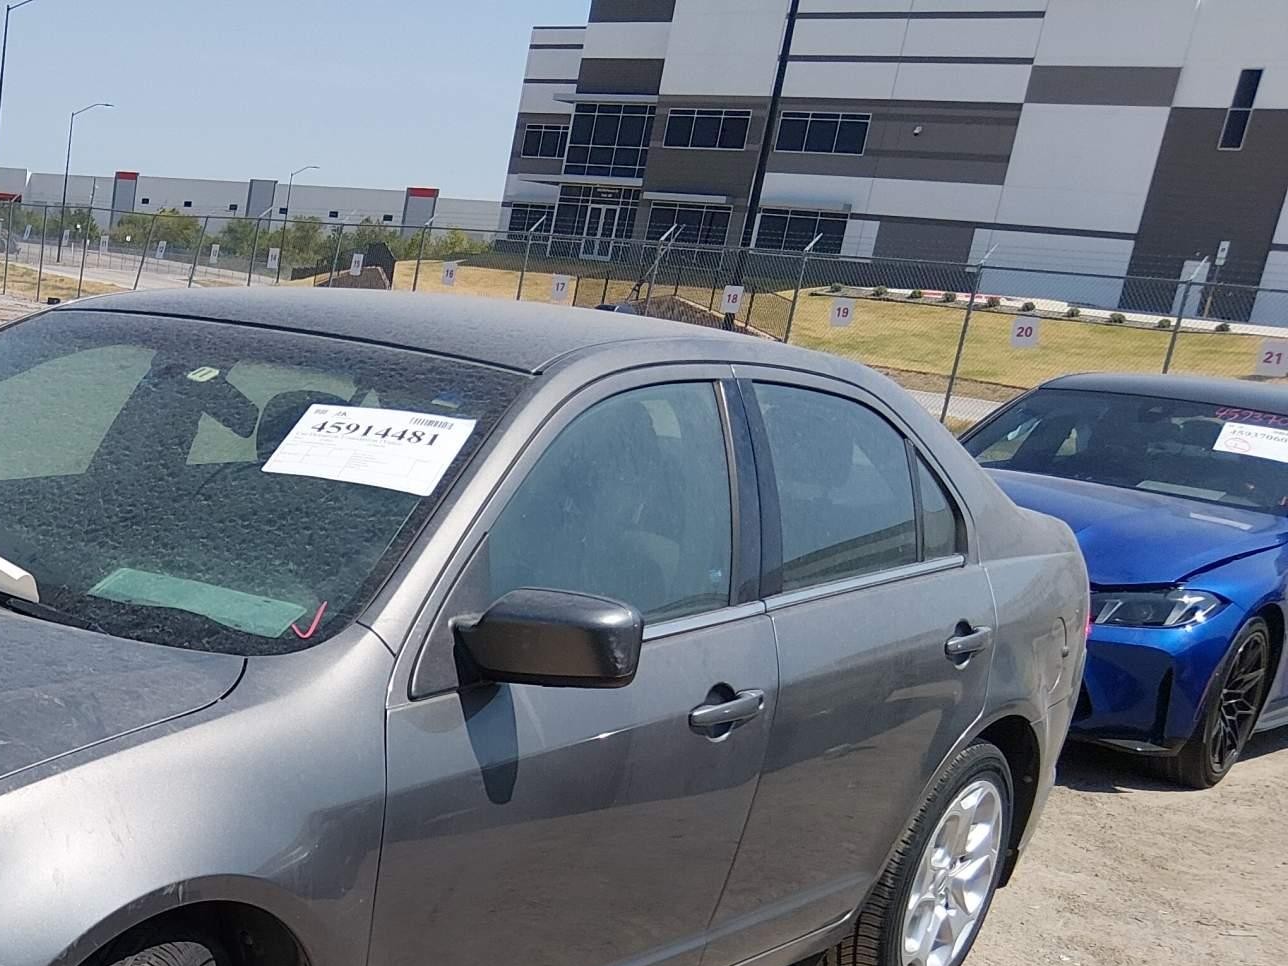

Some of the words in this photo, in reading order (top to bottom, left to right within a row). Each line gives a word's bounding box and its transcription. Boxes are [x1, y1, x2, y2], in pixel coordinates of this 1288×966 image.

[445, 269, 454, 278] 16
[555, 282, 565, 292] 17
[727, 293, 738, 304] 18
[836, 307, 849, 318] 19
[1016, 326, 1033, 338] 20
[1263, 351, 1283, 365] 21
[312, 420, 439, 446] 45914481
